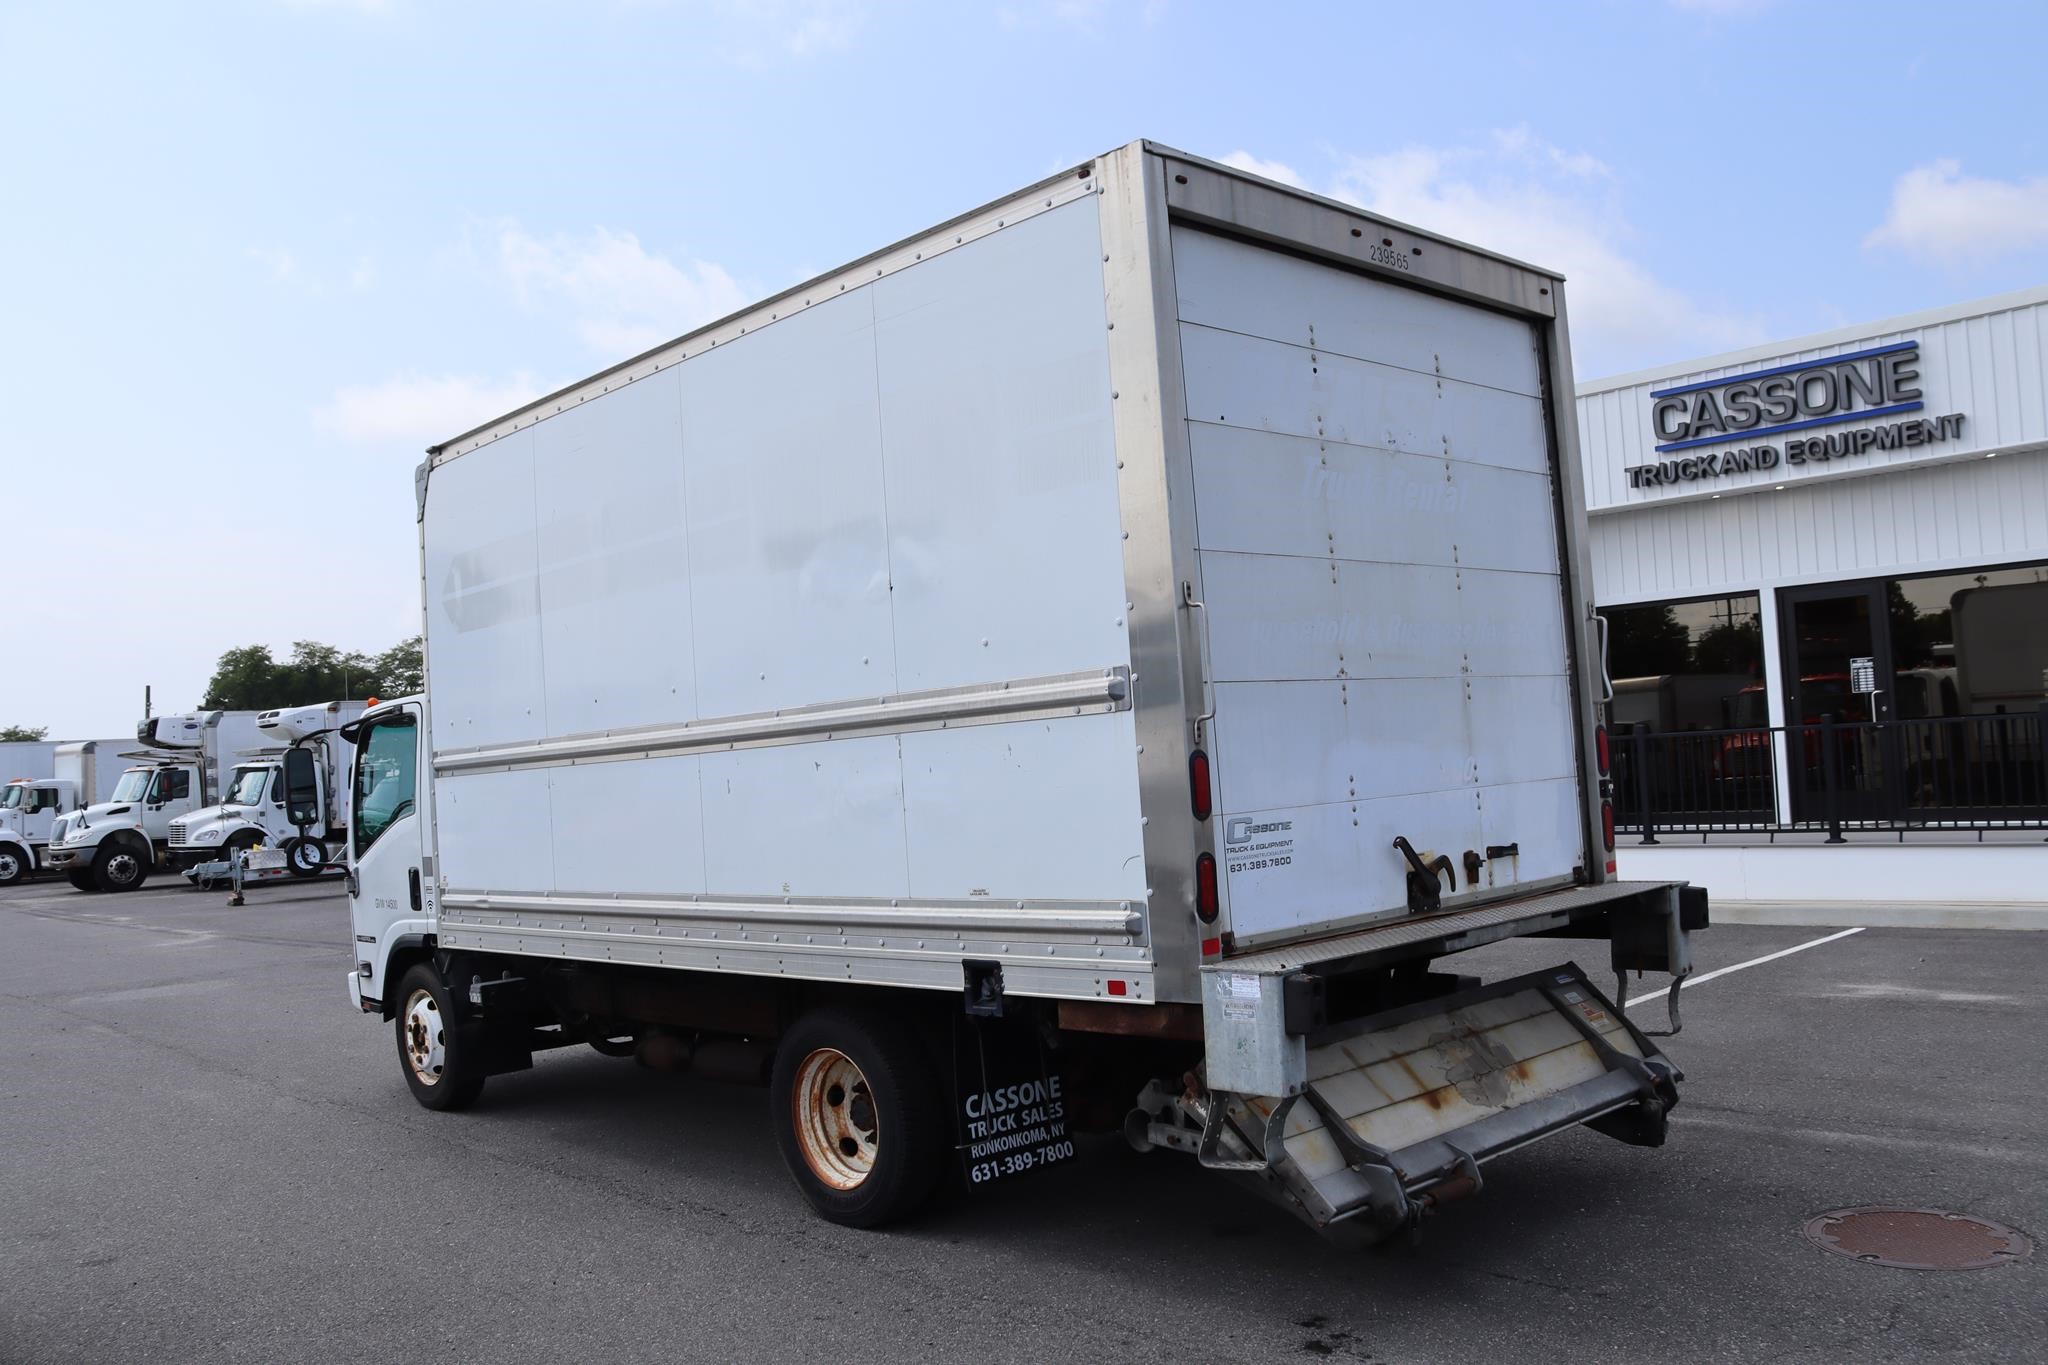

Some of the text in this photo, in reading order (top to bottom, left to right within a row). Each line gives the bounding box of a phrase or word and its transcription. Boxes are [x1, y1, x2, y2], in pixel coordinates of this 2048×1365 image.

[1370, 244, 1409, 270] 239565
[1652, 350, 1923, 443] CASSONE
[1625, 413, 1965, 488] TRUCK AND EQUIPMENT
[1226, 846, 1249, 854] TRUCK
[1256, 840, 1293, 850] EQUIPMENT
[1230, 856, 1292, 873] 631.389.7800
[965, 1075, 1062, 1118] CASSONE
[968, 1102, 1064, 1139] TRUCK SALES
[971, 1123, 1065, 1159] RONKONKOMA, NY
[972, 1141, 1074, 1183] 631-389-7800
